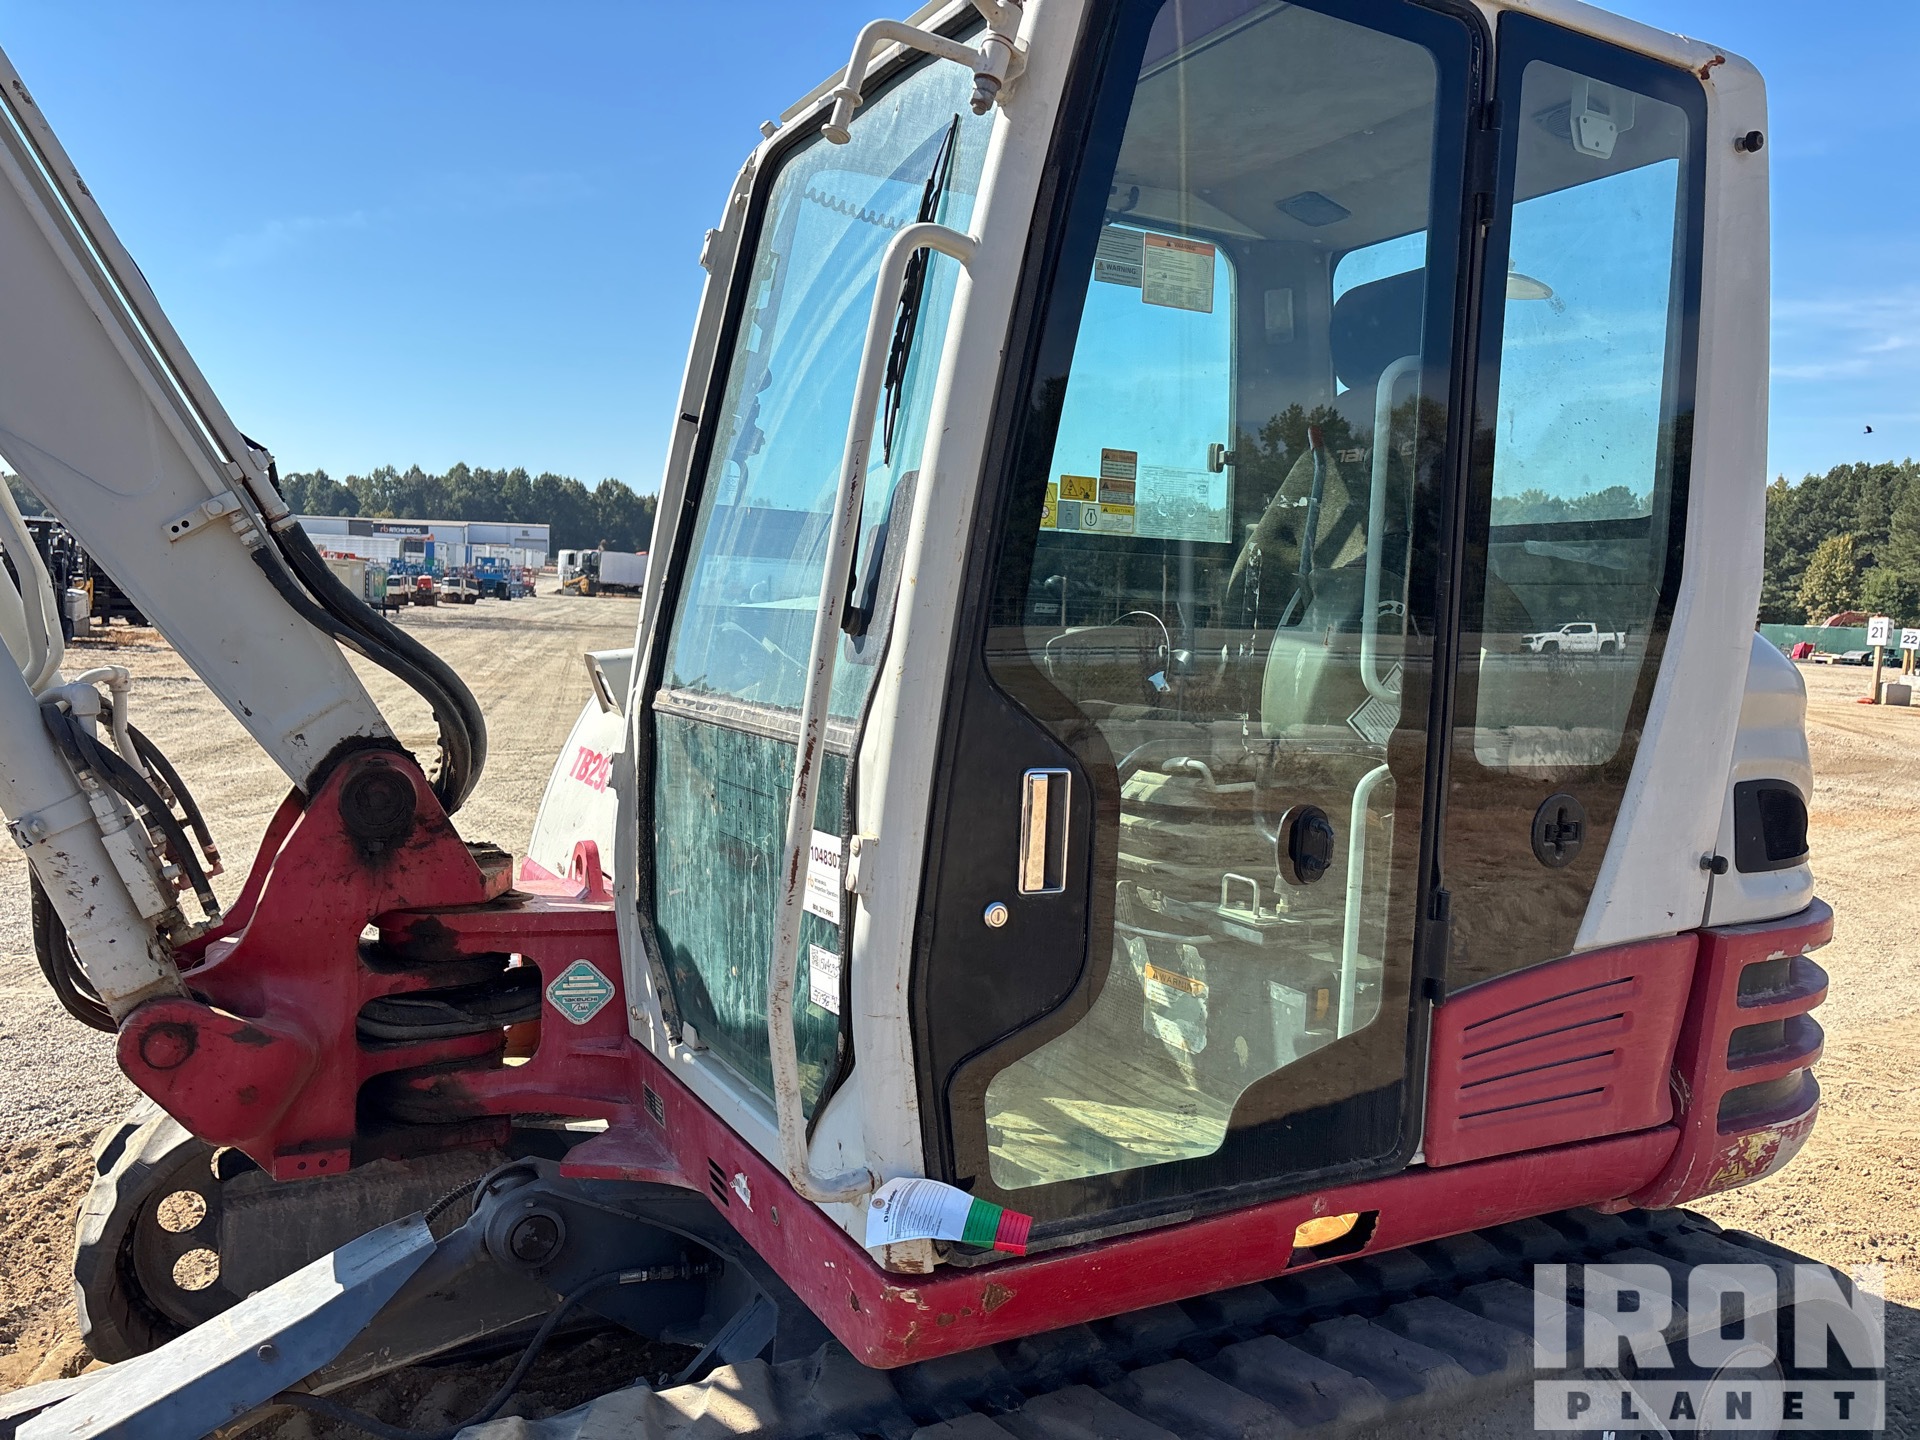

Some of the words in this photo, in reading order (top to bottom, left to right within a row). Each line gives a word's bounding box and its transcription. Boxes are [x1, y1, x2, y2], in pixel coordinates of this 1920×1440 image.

[1106, 263, 1136, 275] WARNING
[1871, 626, 1883, 638] 21
[1903, 635, 1918, 644] 22
[569, 746, 611, 794] TB29
[810, 845, 841, 870] 1048307
[1160, 973, 1194, 993] WARNIN
